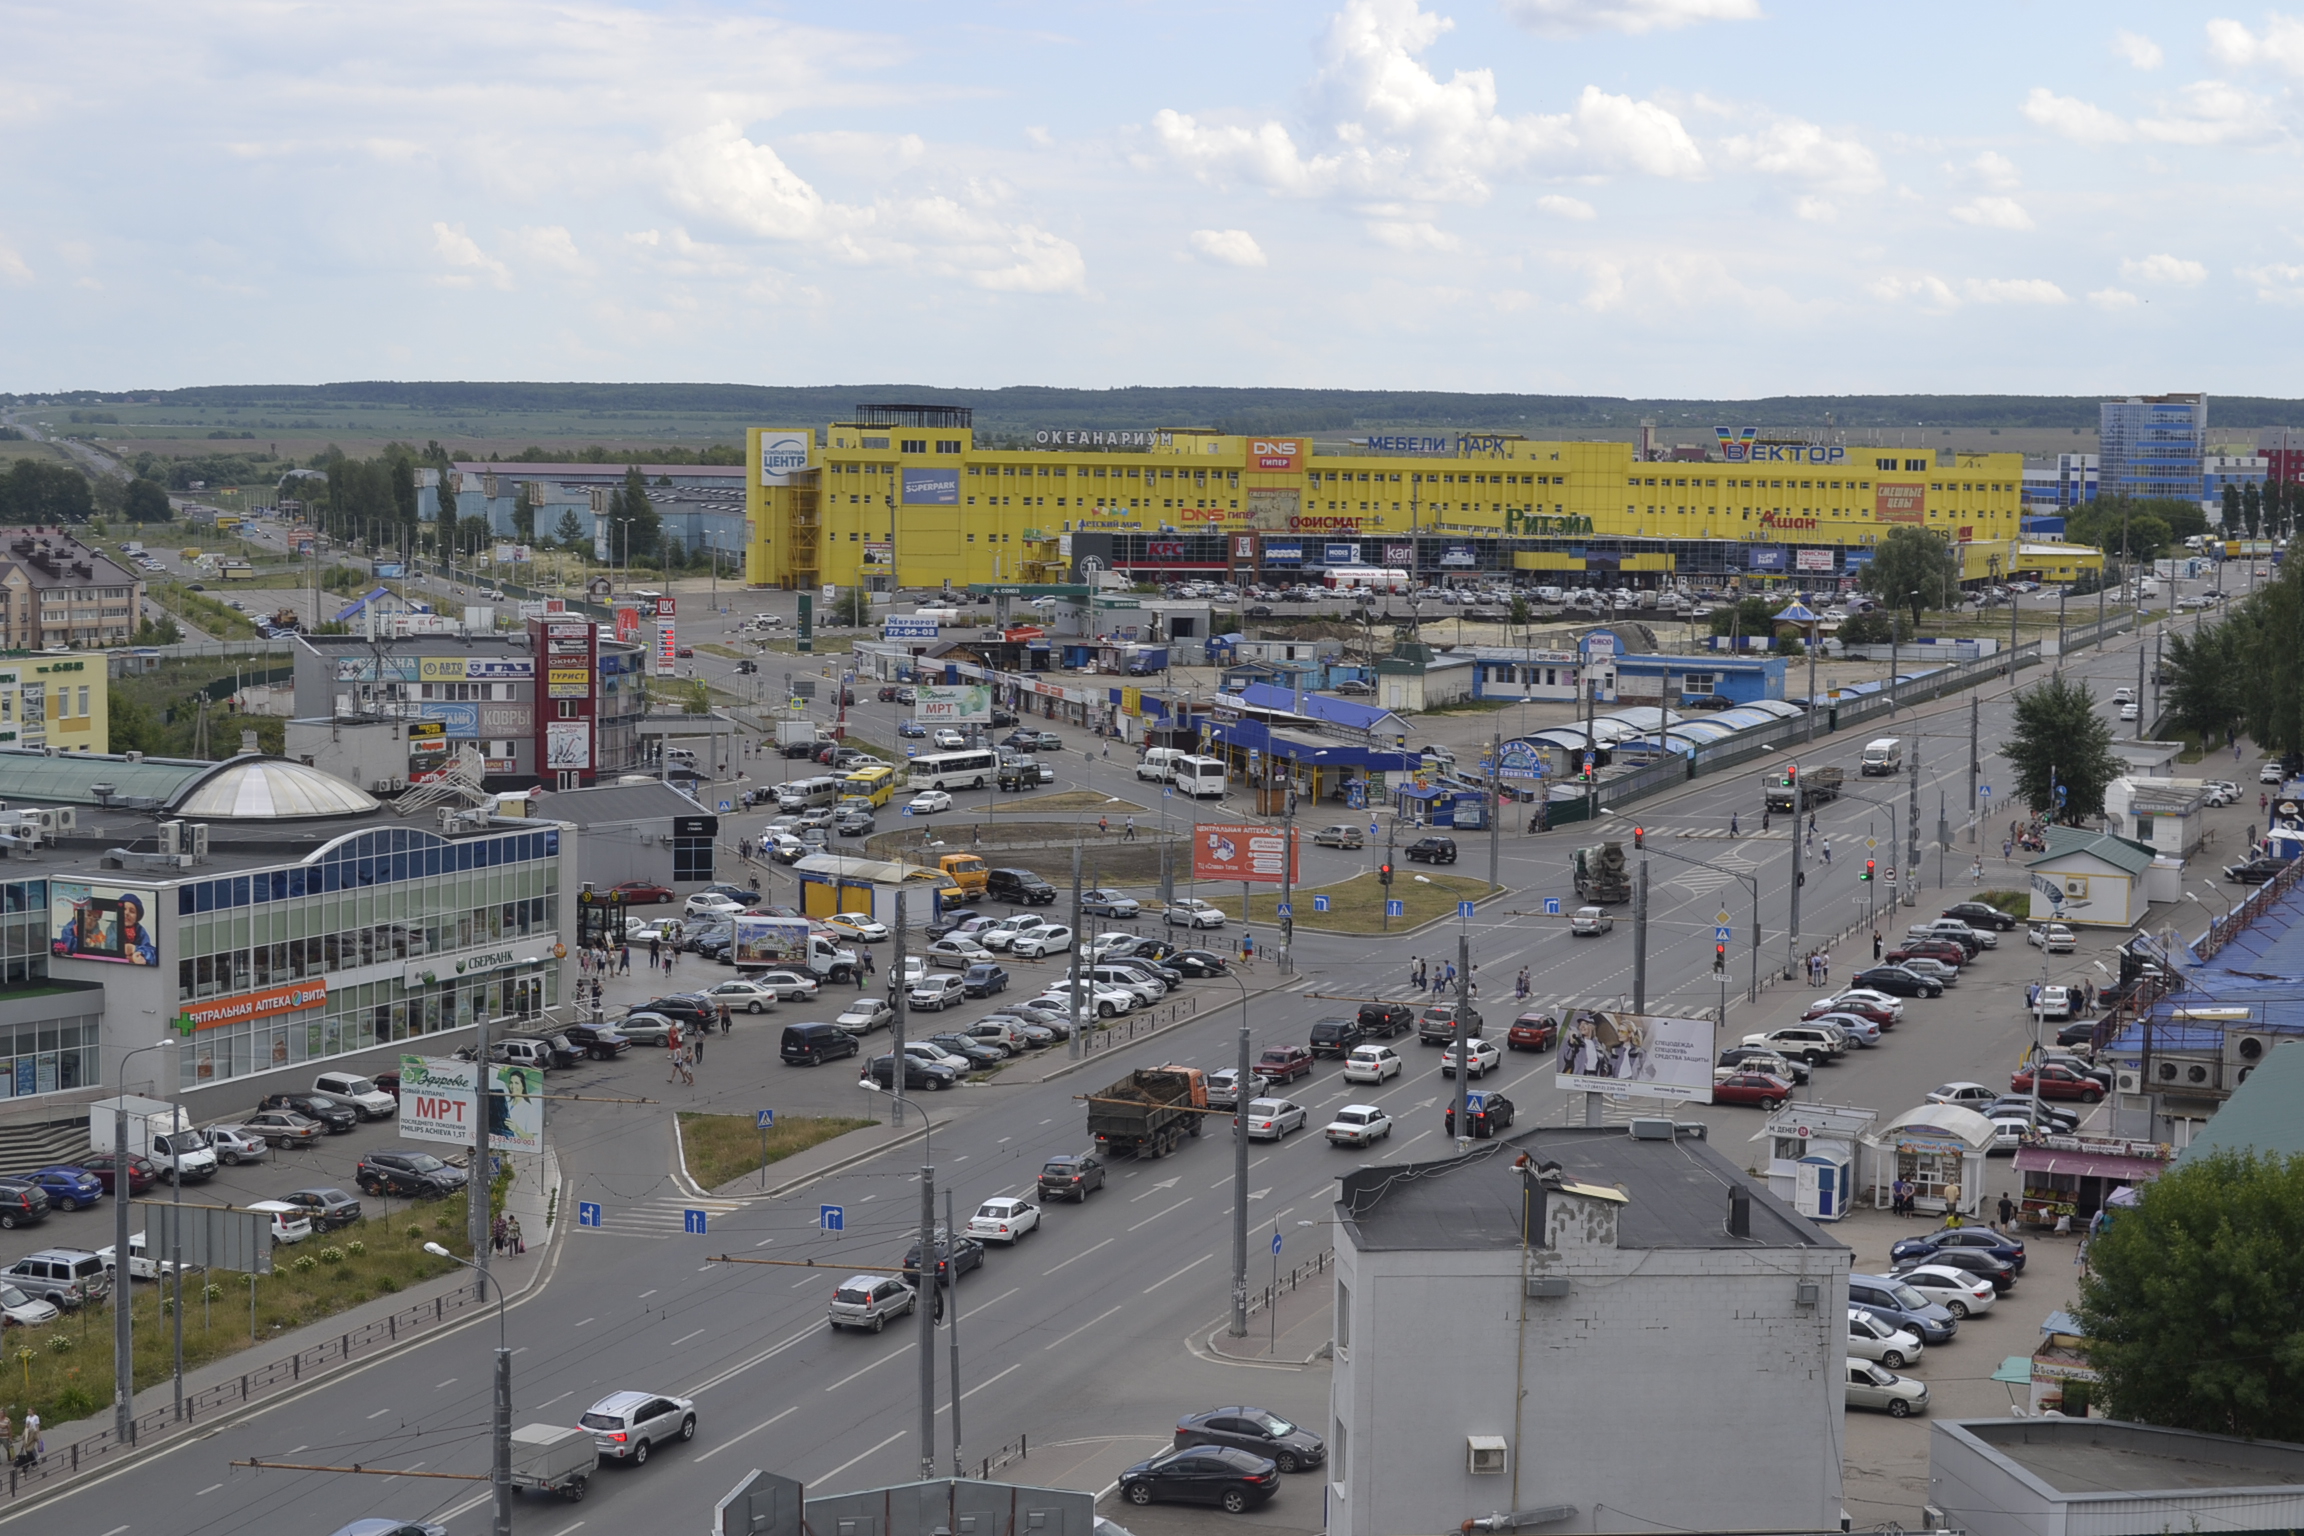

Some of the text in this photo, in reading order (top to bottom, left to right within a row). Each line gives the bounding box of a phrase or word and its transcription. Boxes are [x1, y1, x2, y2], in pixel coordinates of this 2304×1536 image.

[1036, 430, 1173, 446] ОКЕАНАРИУМ
[1253, 442, 1297, 455] DNS
[1368, 436, 1506, 453] МЕБЕЛИ ПАРК
[1726, 444, 1845, 462] ВЕКТОР
[764, 456, 806, 468] ЦЕНТР
[1262, 458, 1288, 467] ГИПЕР
[1877, 486, 1923, 498] СМЕШНЫЕ
[1886, 497, 1914, 509] ЦЕНЫ
[1181, 508, 1225, 521] DNS
[1227, 510, 1256, 520] ГИПЕР
[1079, 517, 1142, 528] Детский мир
[1289, 516, 1363, 529] ОФИСМАГ
[1148, 541, 1184, 556] KFC
[1329, 549, 1348, 557] MODIS
[1352, 547, 1359, 557] 2
[1387, 544, 1413, 559] kari
[485, 663, 531, 672] ГАЗ
[926, 703, 953, 714] МРТ
[484, 711, 530, 725] КОВРЫ
[1498, 743, 1537, 764] РМАРКА
[2134, 803, 2185, 811] СВЯЗНОЙ
[468, 950, 514, 970] СБЕРБАНК
[190, 988, 326, 1024] ЕНТРАЛЬНАЯ АПТЕКА ВИТА
[1655, 1040, 1694, 1048] СПЕЦОДЕЖДА
[1655, 1053, 1682, 1061] СРЕДСТВА
[417, 1069, 470, 1088] Здоровье
[401, 1087, 445, 1098] НОВЫЙ АППАРАТ
[416, 1097, 467, 1122] МРТ
[401, 1118, 466, 1130] ПОСЛЕДНЕГО ПОКОЛЕНИЯ
[401, 1125, 424, 1133] PHILIPS
[425, 1127, 451, 1136] ACHIEVA
[509, 1137, 535, 1146] 750-003
[1903, 1142, 1937, 1151] ВКУСНЫЙ
[2050, 1137, 2076, 1145] фрукты
[2084, 1144, 2124, 1152] сухофрукты
